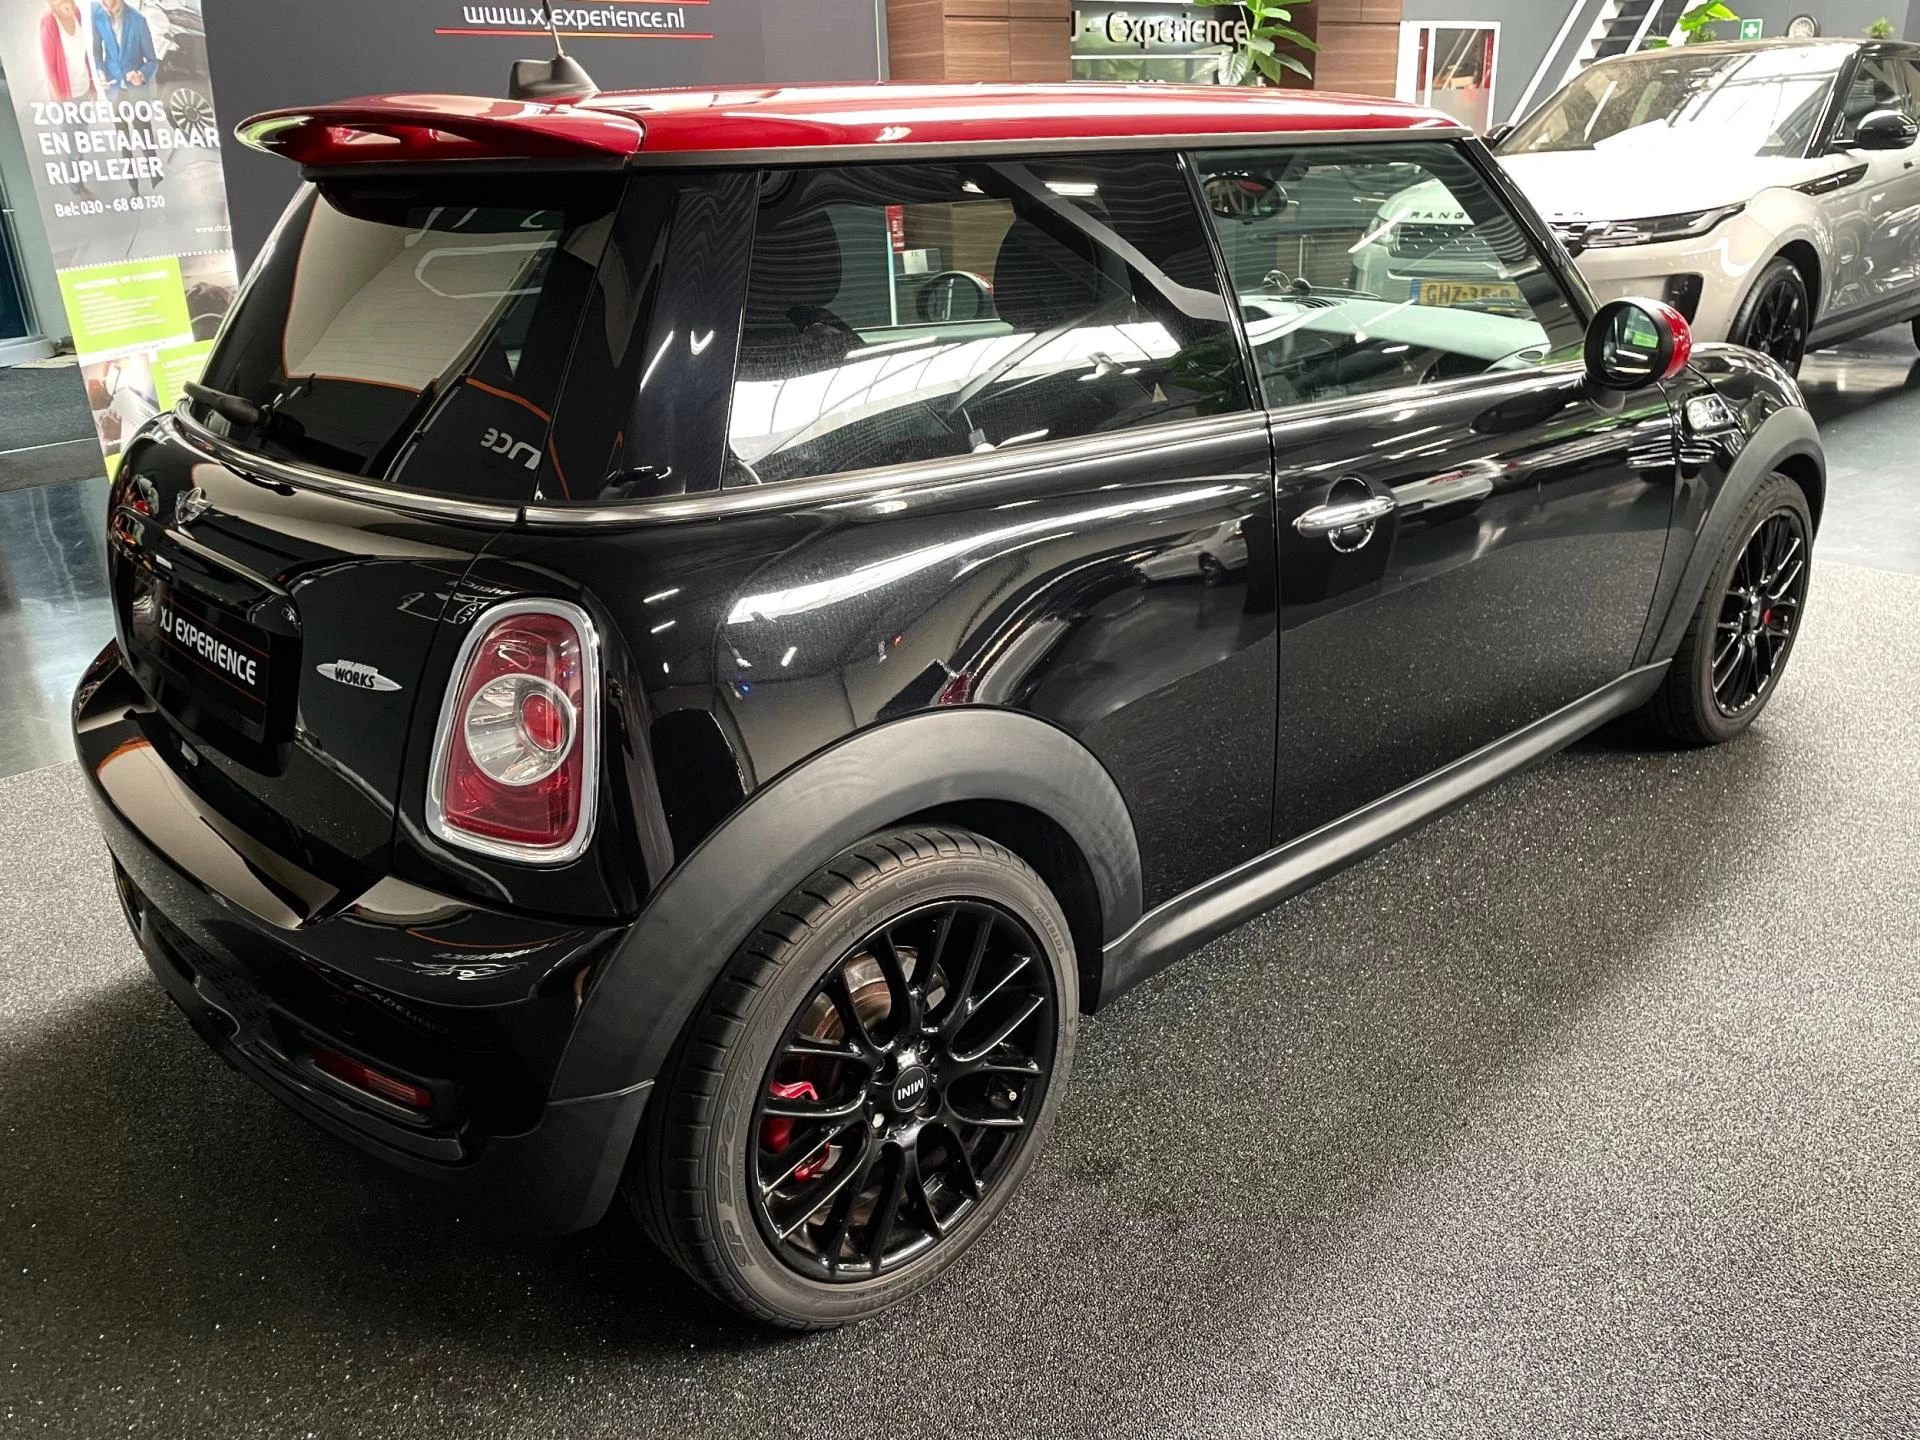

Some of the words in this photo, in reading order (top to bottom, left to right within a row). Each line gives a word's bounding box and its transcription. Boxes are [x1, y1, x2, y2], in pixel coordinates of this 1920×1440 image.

[1107, 11, 1250, 49] Experience
[30, 100, 166, 125] ZORGELOOS
[38, 132, 71, 155] EN
[74, 127, 220, 153] BETAALBAAR
[45, 156, 165, 185] RIJPLEZIER
[54, 201, 80, 217] Bel:
[80, 199, 104, 214] 030
[113, 198, 129, 212] 68
[130, 196, 144, 210] 68
[144, 194, 165, 209] 750
[160, 605, 173, 632] XJ
[175, 617, 257, 686] EXPERIENCE
[334, 667, 376, 689] WORKS
[897, 1077, 924, 1101] MINI
